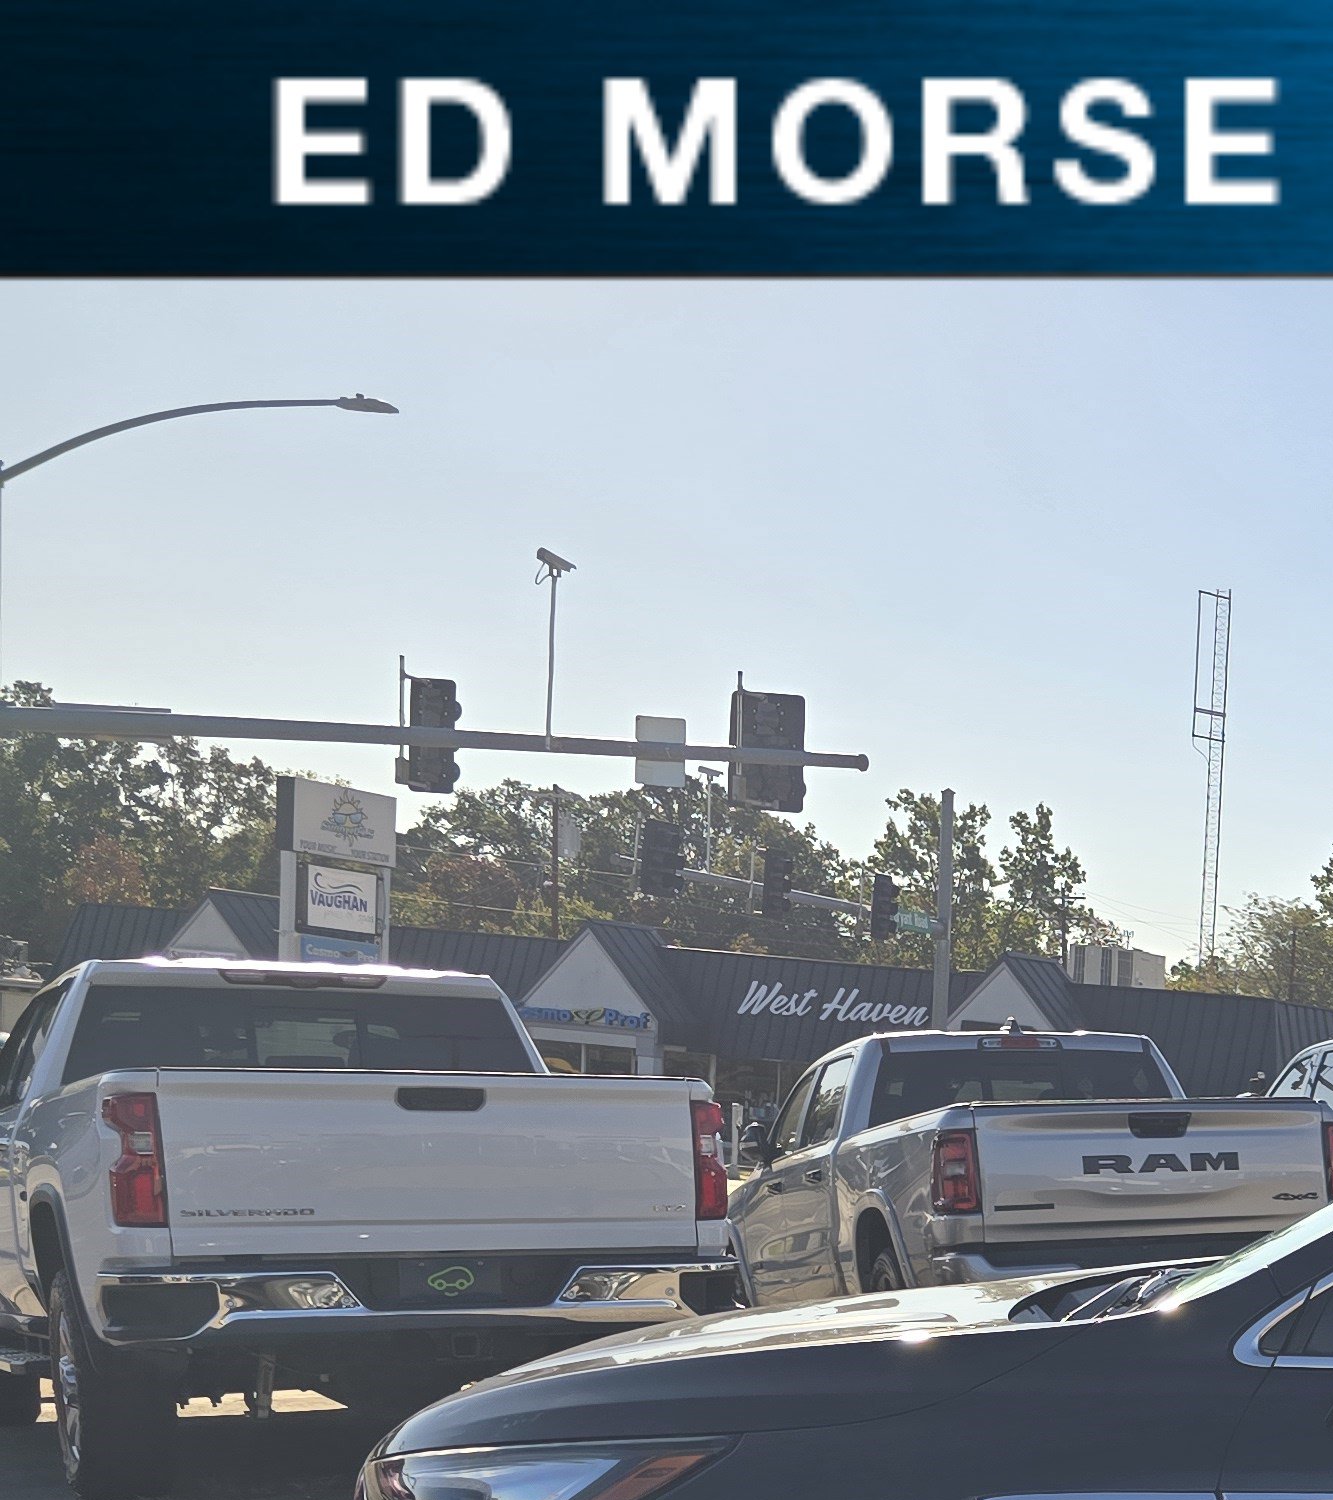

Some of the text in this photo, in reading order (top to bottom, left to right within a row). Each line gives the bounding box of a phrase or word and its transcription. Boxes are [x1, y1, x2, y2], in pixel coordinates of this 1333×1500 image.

[310, 889, 368, 912] VAUGHAN
[737, 980, 929, 1027] West Haven
[604, 1008, 650, 1029] Prof
[1081, 1151, 1240, 1175] RAM
[179, 1208, 316, 1218] SILVERADO
